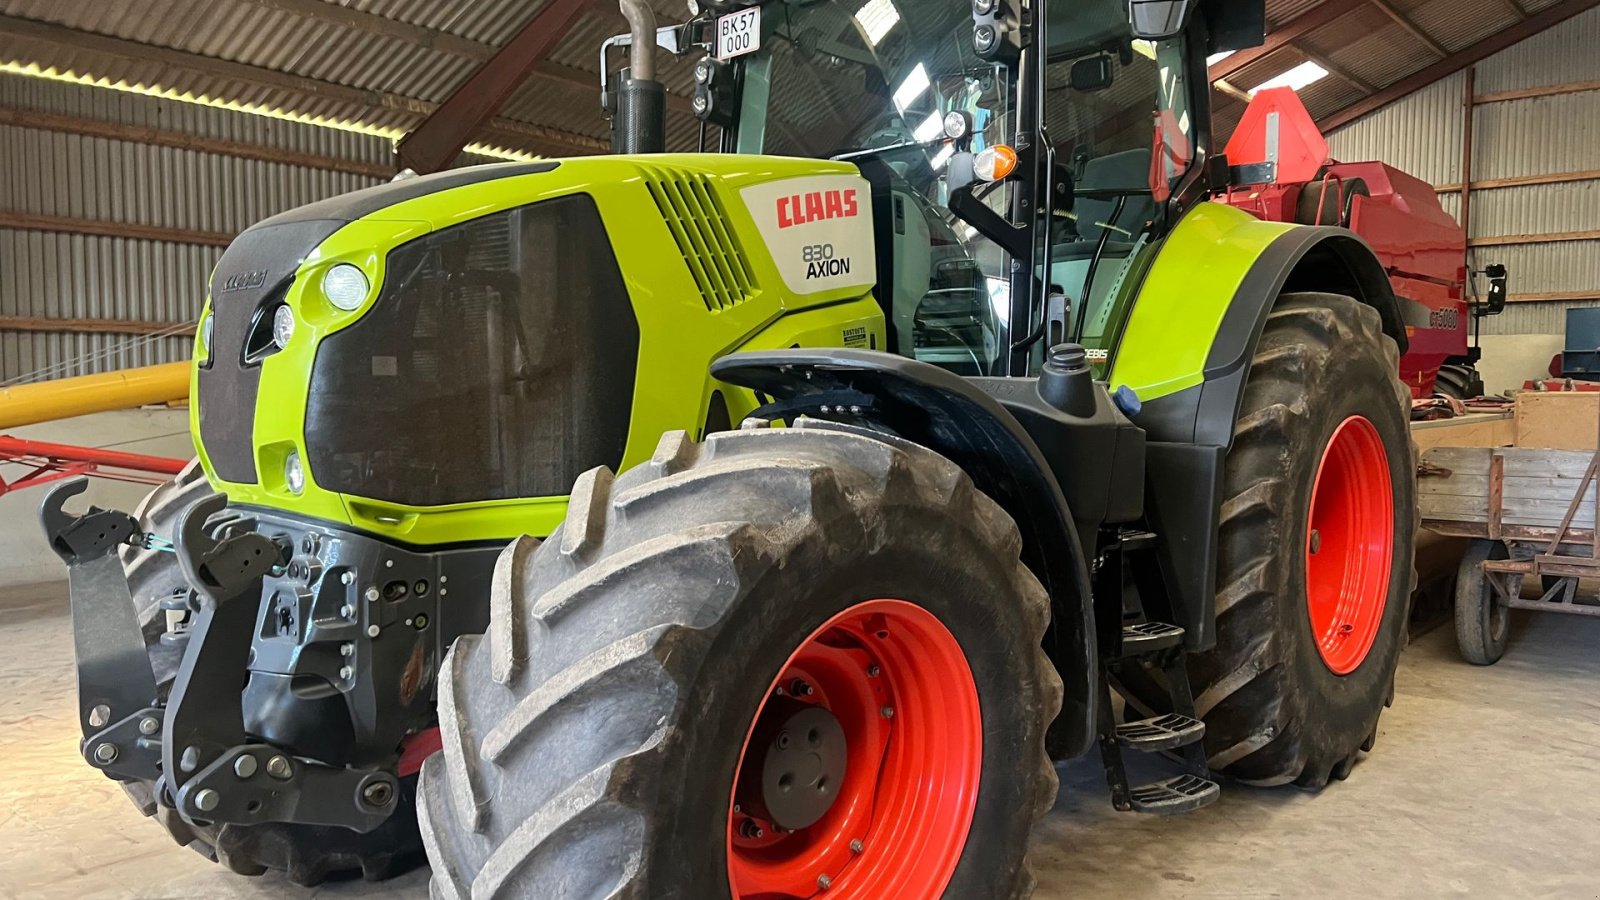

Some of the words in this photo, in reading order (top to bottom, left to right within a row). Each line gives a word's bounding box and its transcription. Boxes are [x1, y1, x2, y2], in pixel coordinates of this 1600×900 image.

[727, 33, 750, 53] 000
[776, 189, 858, 229] CLAAS
[802, 243, 834, 263] 830
[806, 257, 850, 280] AXION
